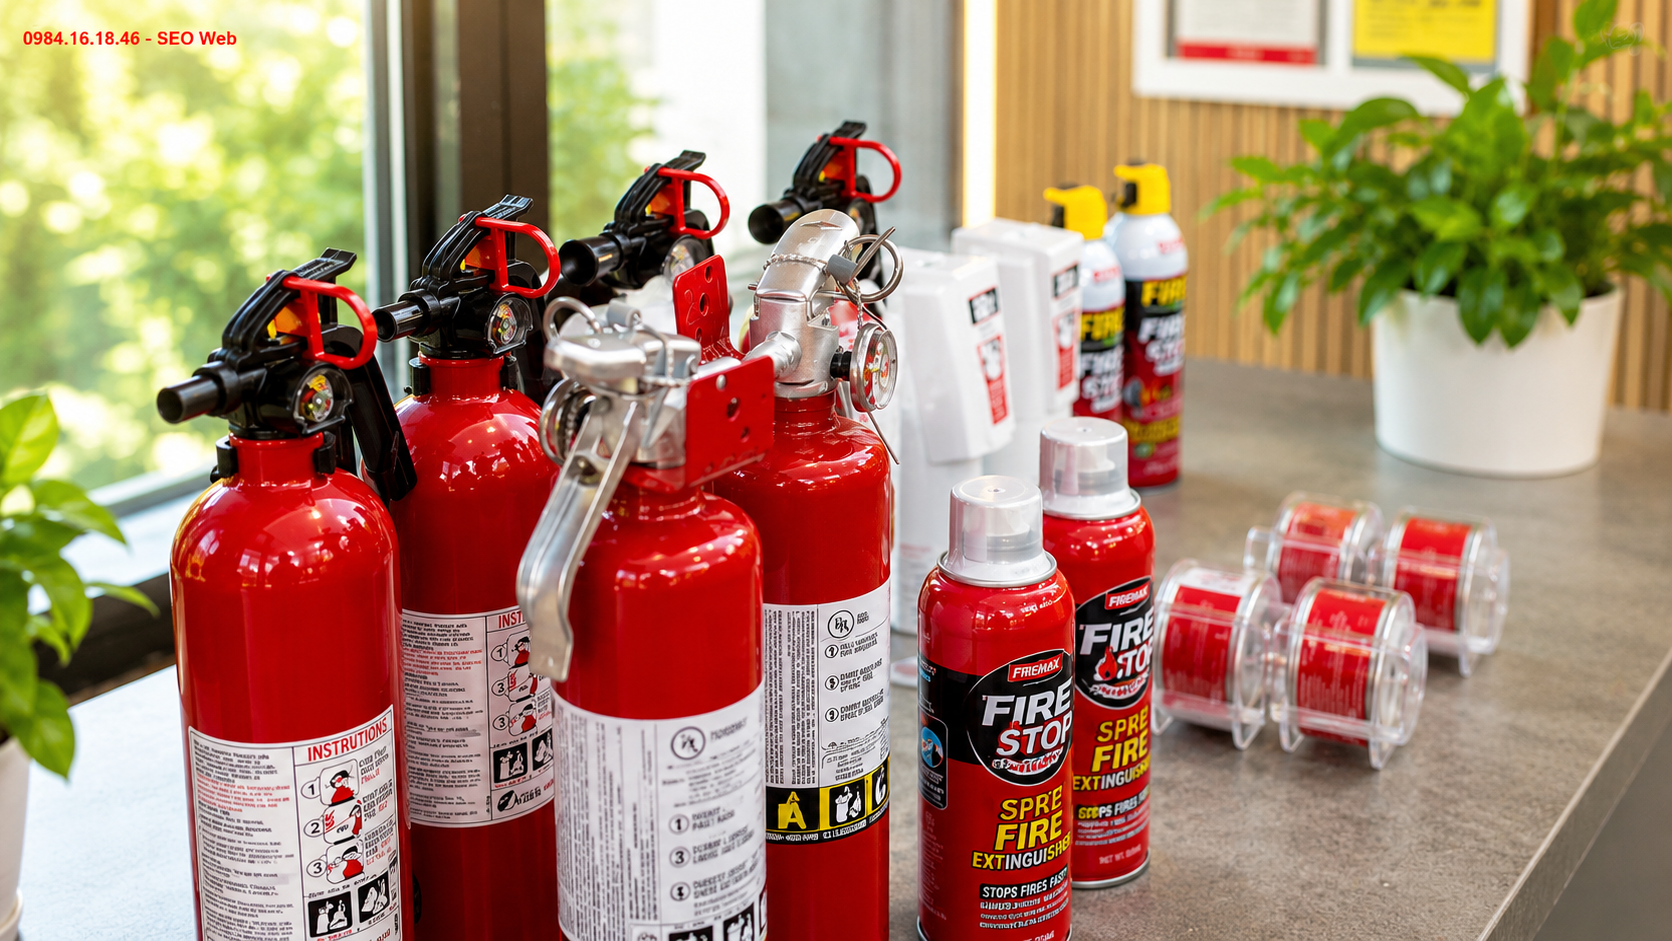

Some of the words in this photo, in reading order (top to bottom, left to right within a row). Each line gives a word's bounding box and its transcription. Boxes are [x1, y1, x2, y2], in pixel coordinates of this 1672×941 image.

[1079, 606, 1154, 655] FIRE
[982, 676, 1072, 726] FIRE
[307, 717, 387, 762] INSTRUTIONS
[995, 710, 1073, 756] STOP
[1091, 729, 1149, 772] FIRE
[994, 809, 1063, 851] FIRE
[982, 886, 1018, 899] STOPS
[1020, 879, 1047, 897] FIRES
